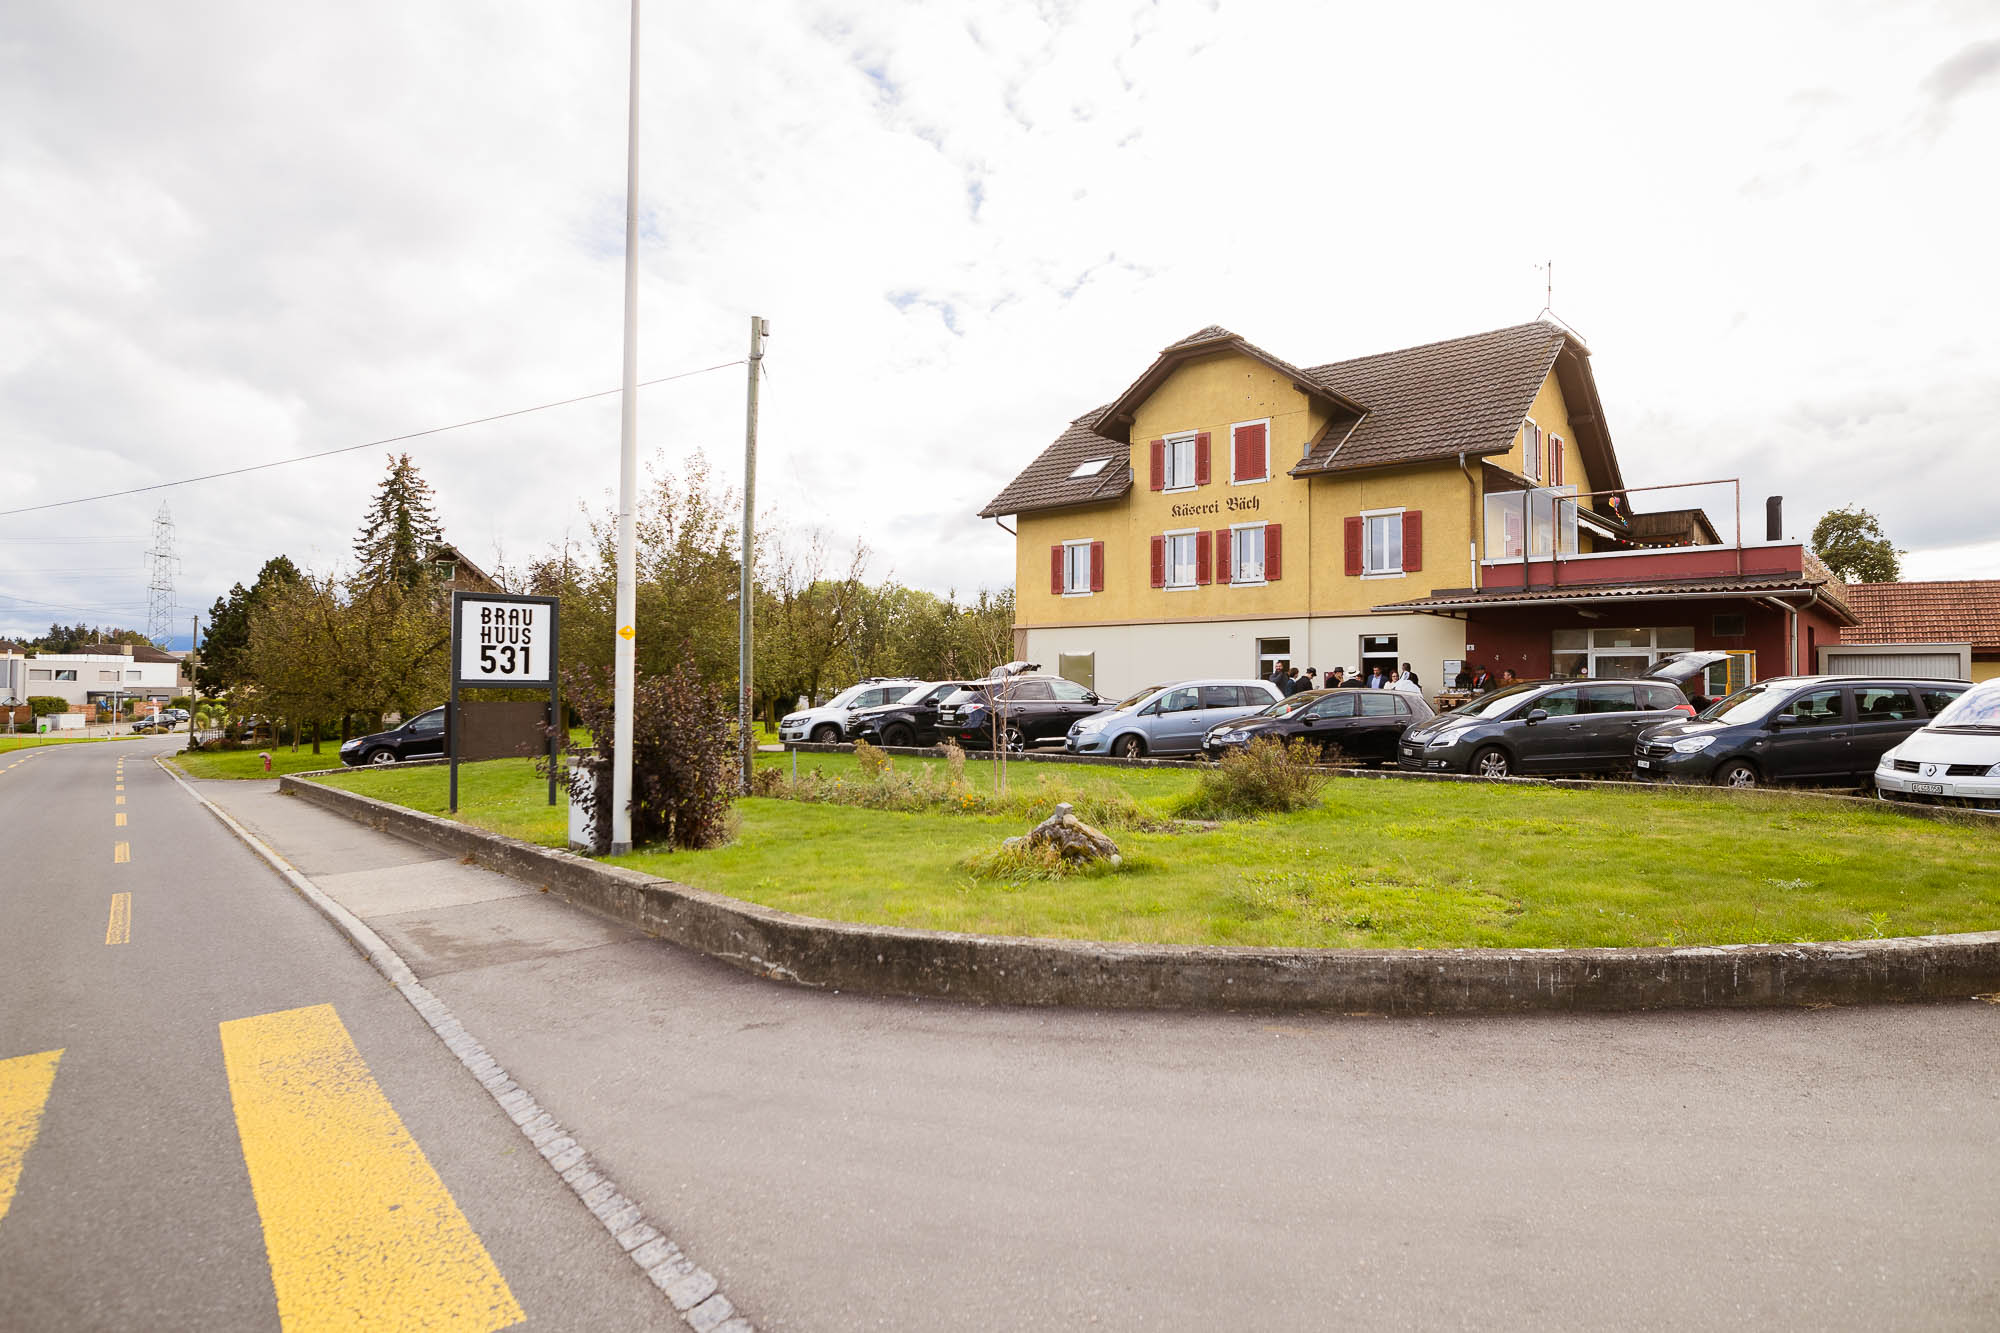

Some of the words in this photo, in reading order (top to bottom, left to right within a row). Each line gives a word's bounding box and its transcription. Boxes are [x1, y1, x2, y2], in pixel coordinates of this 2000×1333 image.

[1171, 500, 1220, 518] Käserei
[1226, 495, 1260, 512] Bäch
[480, 606, 533, 626] BRAU
[480, 627, 532, 645] HUUS
[480, 645, 530, 675] 531
